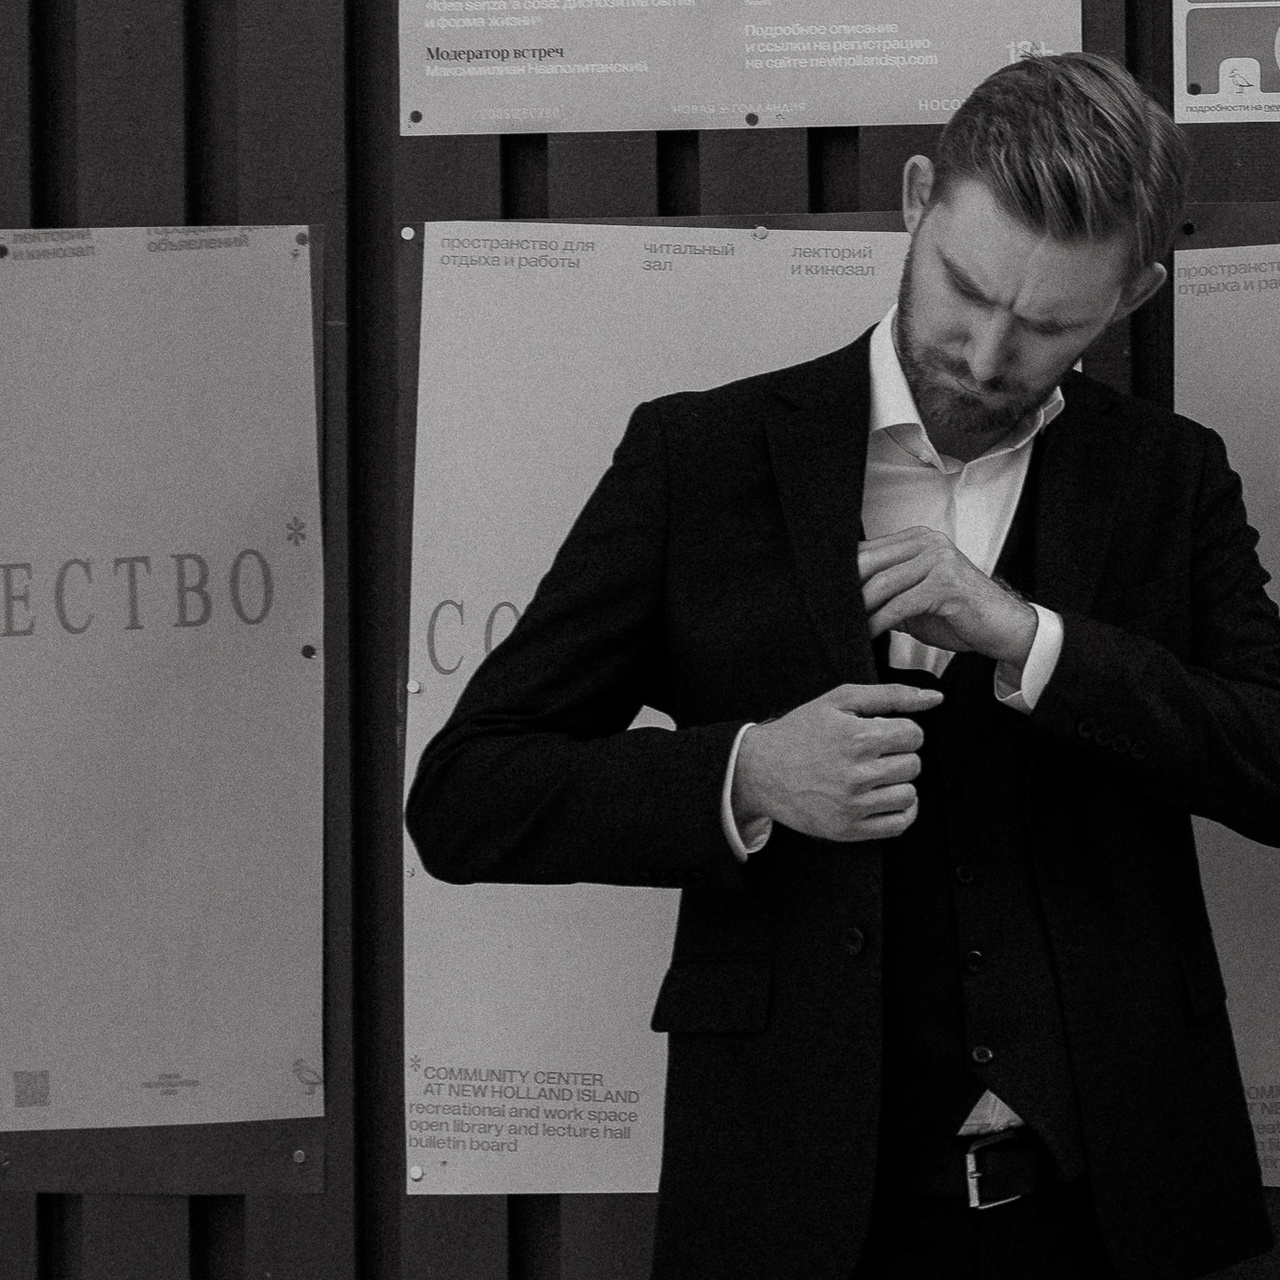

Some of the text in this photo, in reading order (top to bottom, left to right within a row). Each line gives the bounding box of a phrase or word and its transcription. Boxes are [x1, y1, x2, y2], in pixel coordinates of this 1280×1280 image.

[745, 23, 898, 38] Подробное описание
[758, 39, 930, 52] ссылки регистрацию
[426, 47, 564, 62] Модератор встреч
[766, 54, 938, 68] сайте newhollandsp.com
[441, 238, 595, 258] пространство для
[644, 244, 735, 256] читальный
[792, 247, 873, 261] лекторий
[441, 254, 581, 269] отдыха работы
[643, 260, 672, 271] зал
[805, 265, 874, 276] кинозал
[1178, 281, 1240, 296] отдыха
[424, 1067, 604, 1086] COMMUNITY CENTER
[424, 1083, 639, 1103] AT NEW HOLLAND ISLAND
[408, 1104, 638, 1123] recreational and work space
[409, 1120, 630, 1139] open library and lecture hall
[409, 1136, 518, 1152] bulletin board
